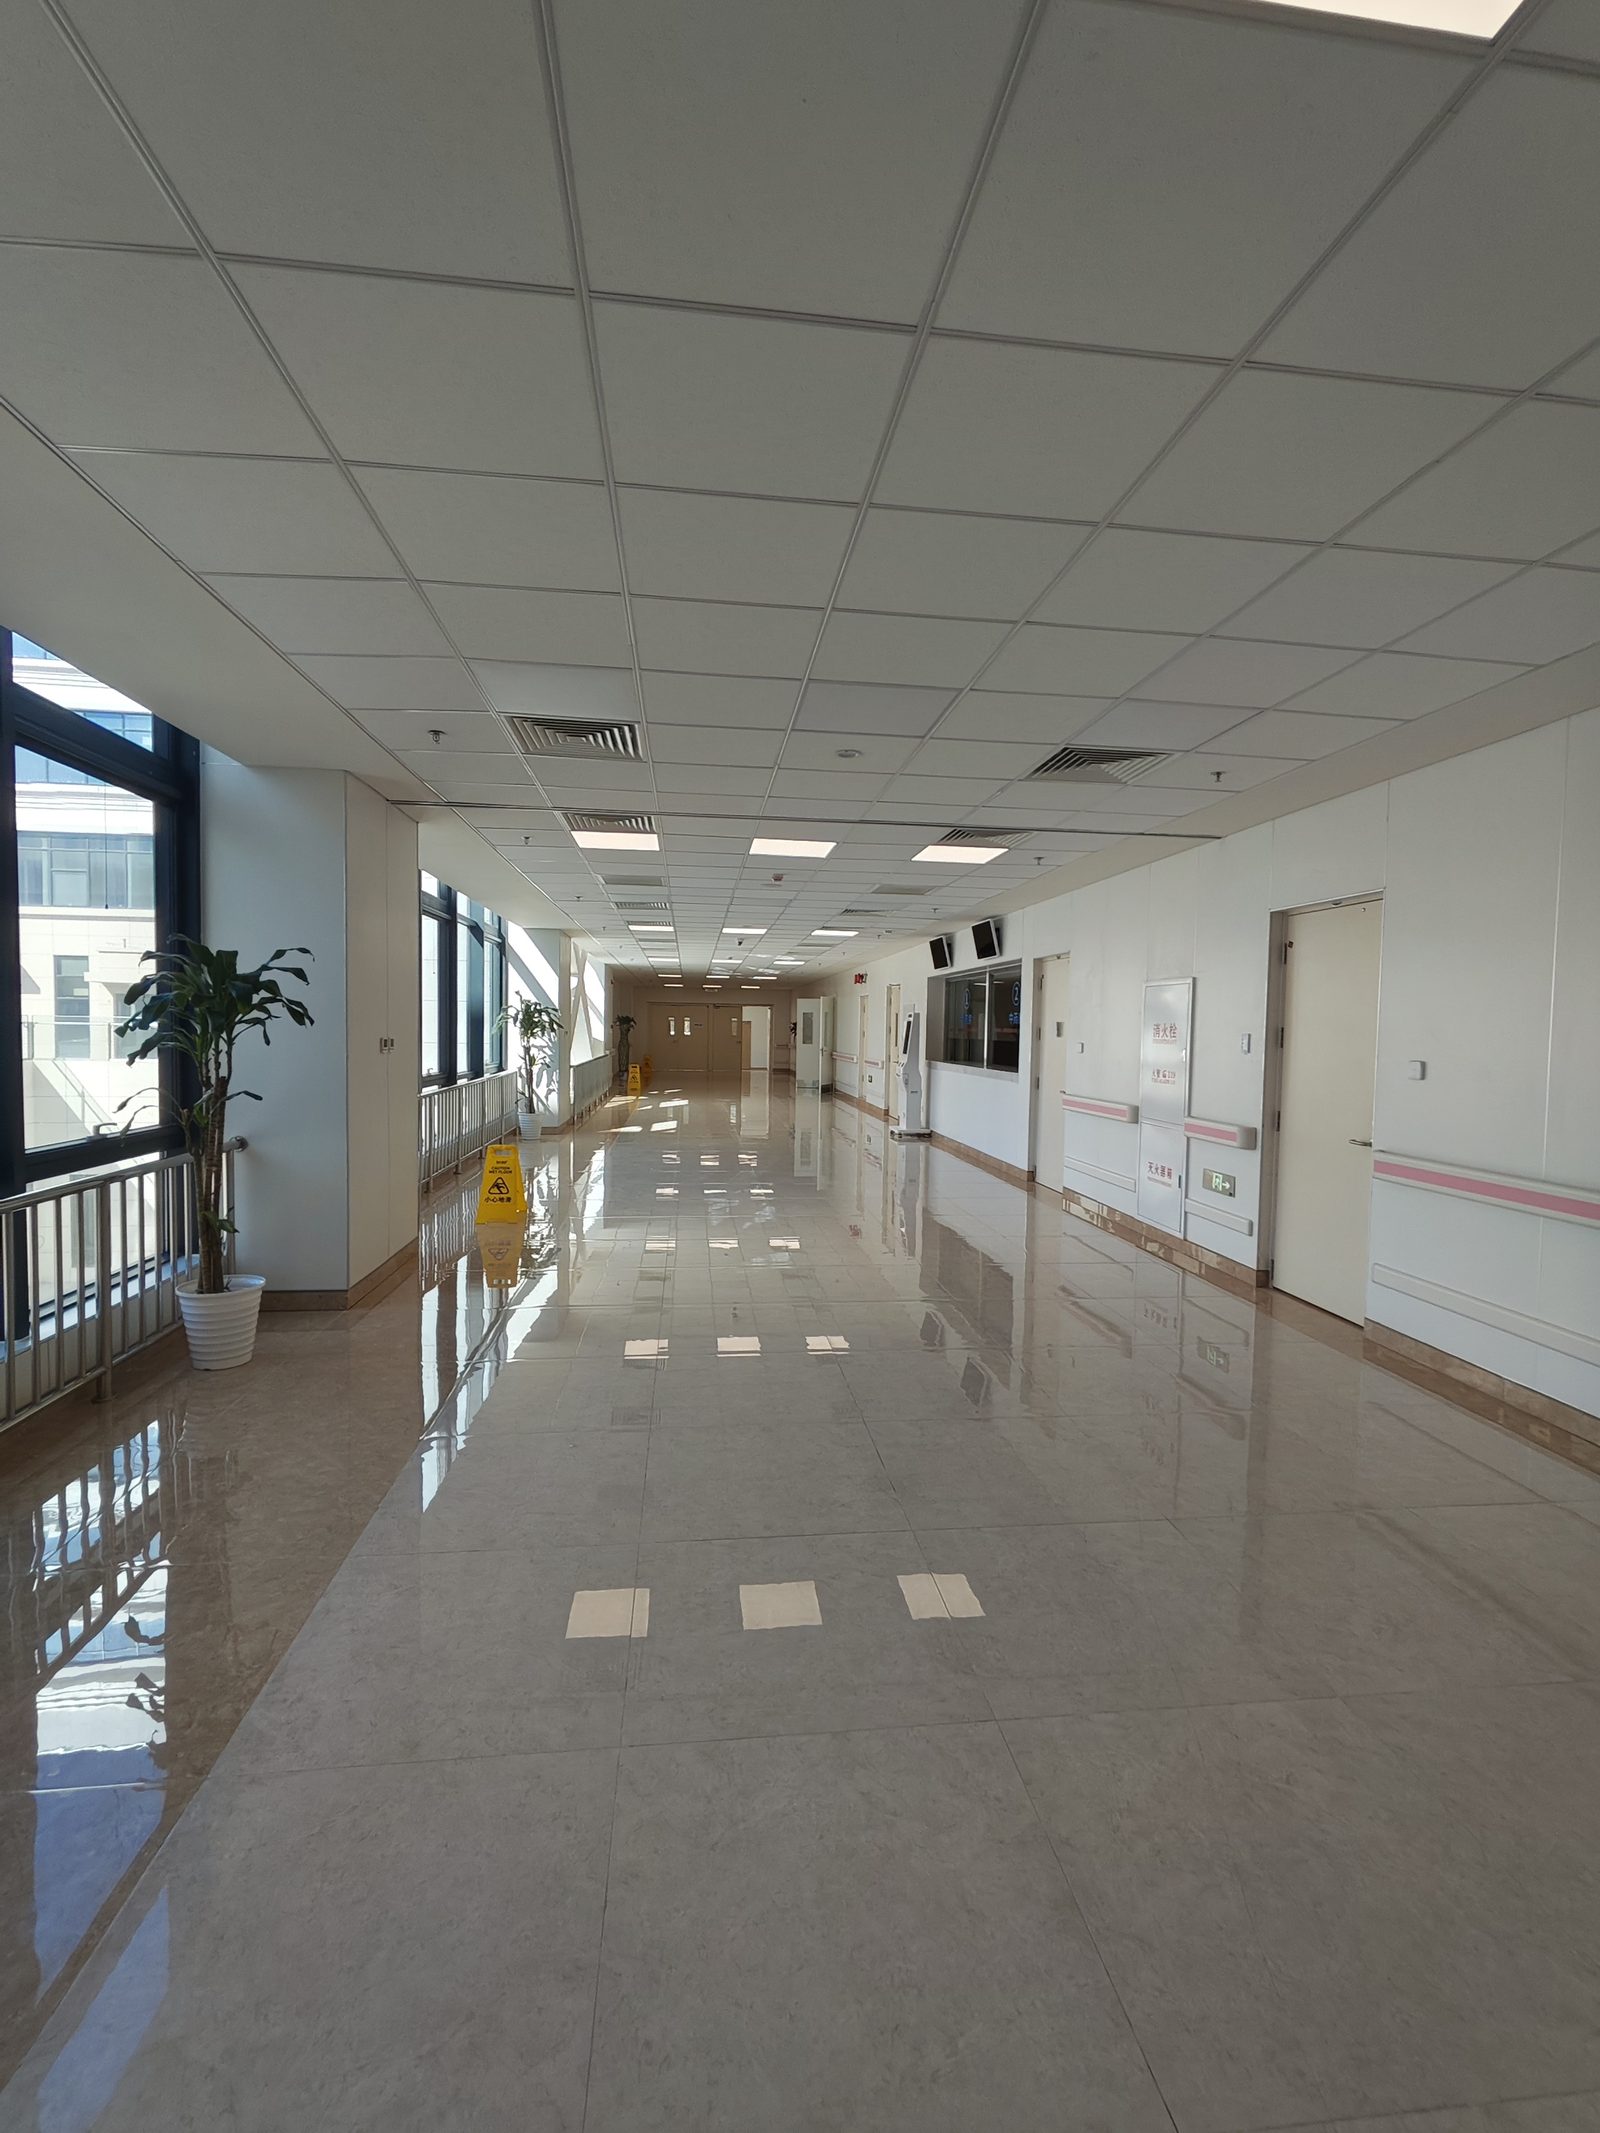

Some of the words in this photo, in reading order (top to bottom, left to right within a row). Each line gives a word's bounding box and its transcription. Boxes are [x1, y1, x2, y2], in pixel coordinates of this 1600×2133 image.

[1153, 1023, 1177, 1038] 消火栓
[1147, 1161, 1172, 1180] 灭火器箱
